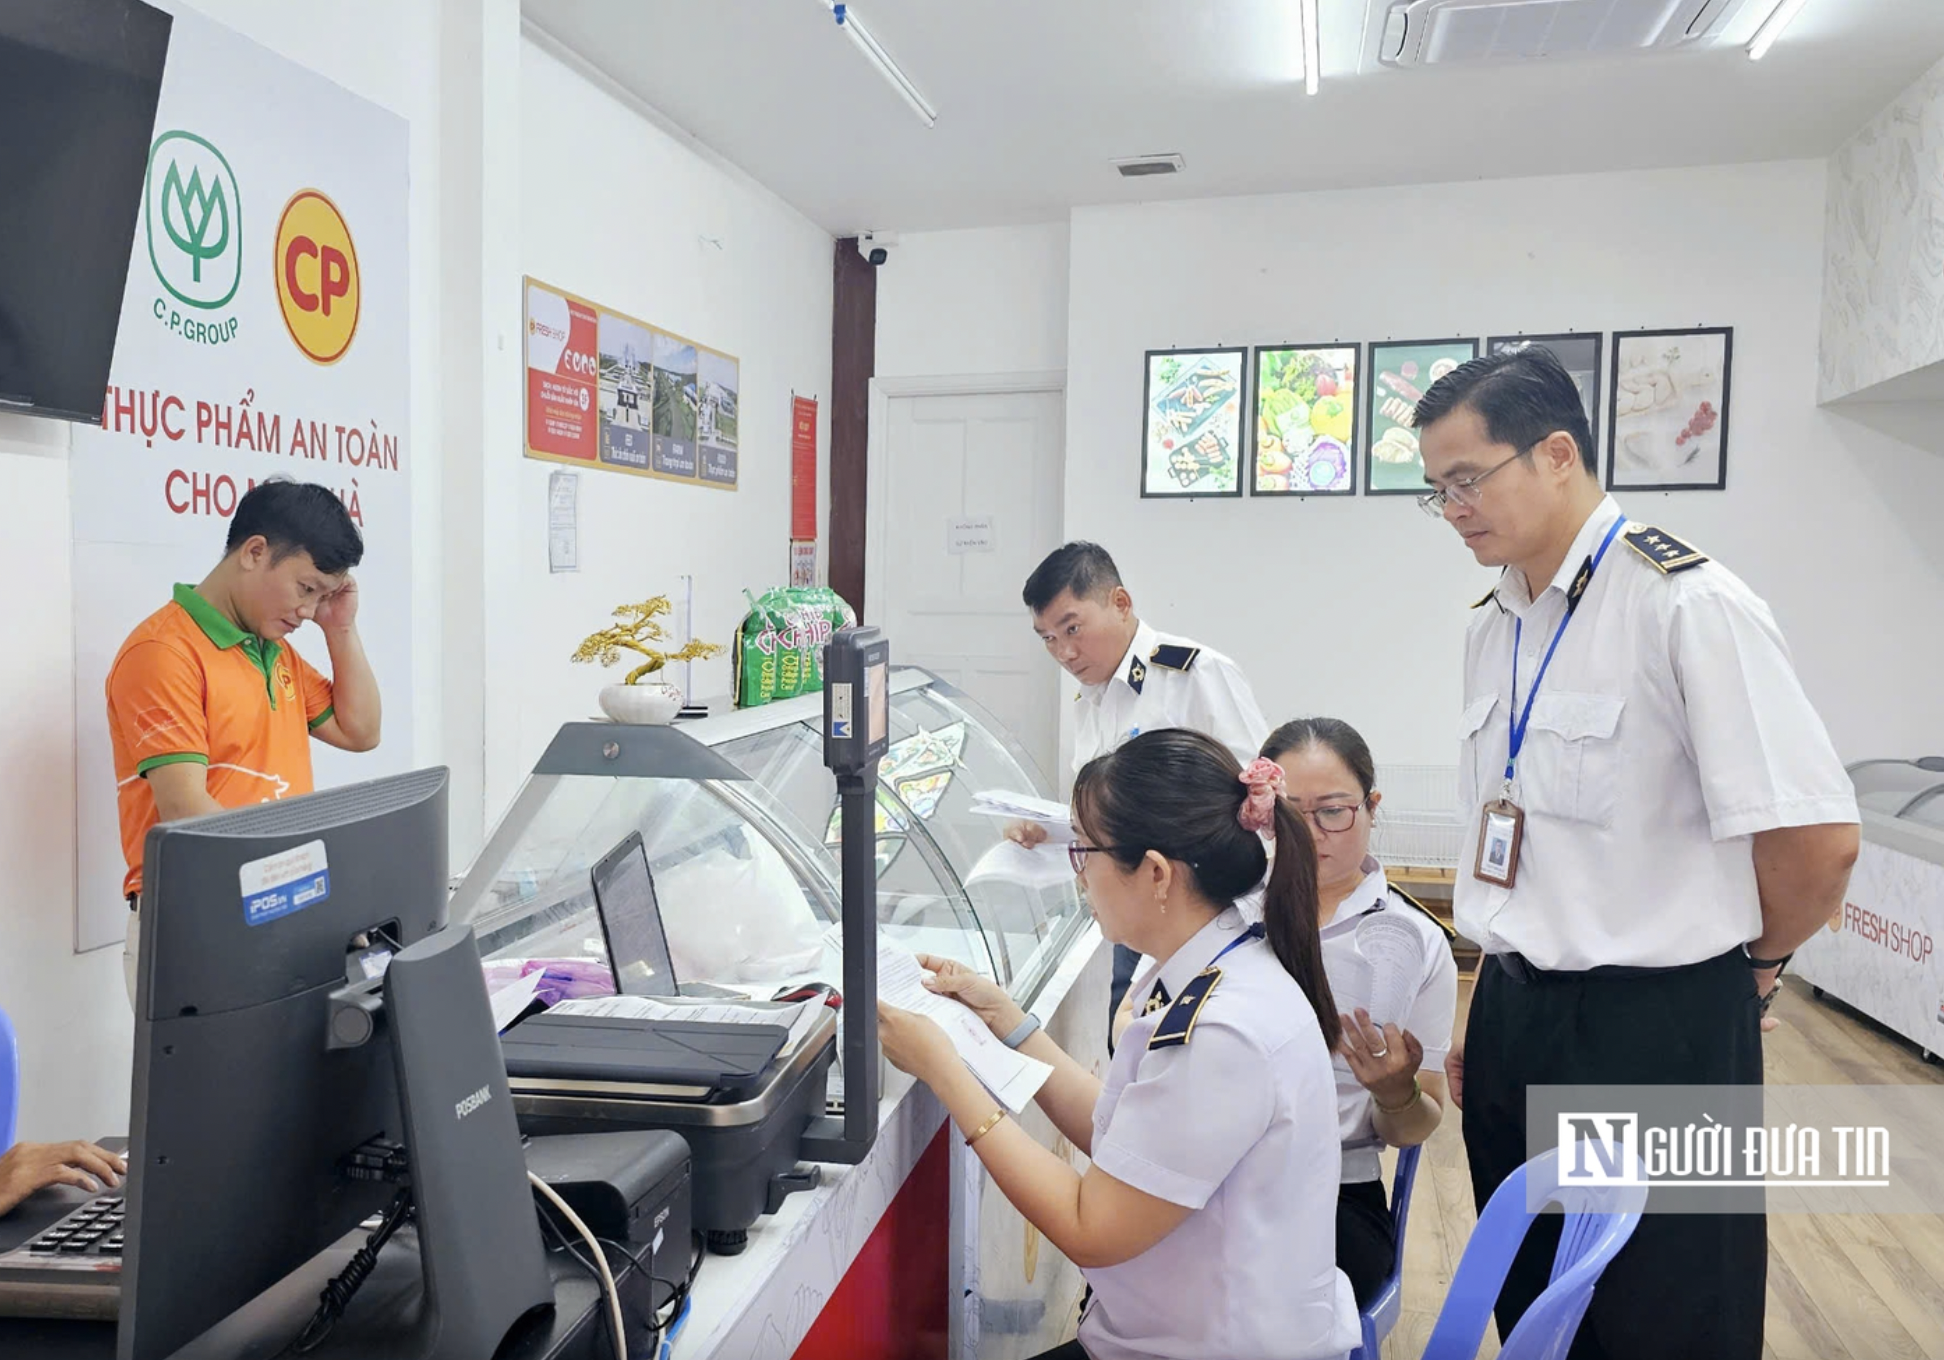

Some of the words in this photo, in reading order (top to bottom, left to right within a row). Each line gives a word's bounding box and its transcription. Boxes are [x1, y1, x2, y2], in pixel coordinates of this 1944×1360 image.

[285, 235, 350, 317] CP
[153, 298, 239, 345] C.P.GROUP
[101, 386, 185, 448] THỰC
[197, 388, 281, 454] PHẨM
[289, 418, 327, 461] AN
[335, 419, 398, 471] TOÀN
[165, 469, 237, 517] CHO
[1844, 902, 1889, 948] FRESH
[1890, 922, 1933, 965] SHOP
[455, 1084, 492, 1120] POSBANK
